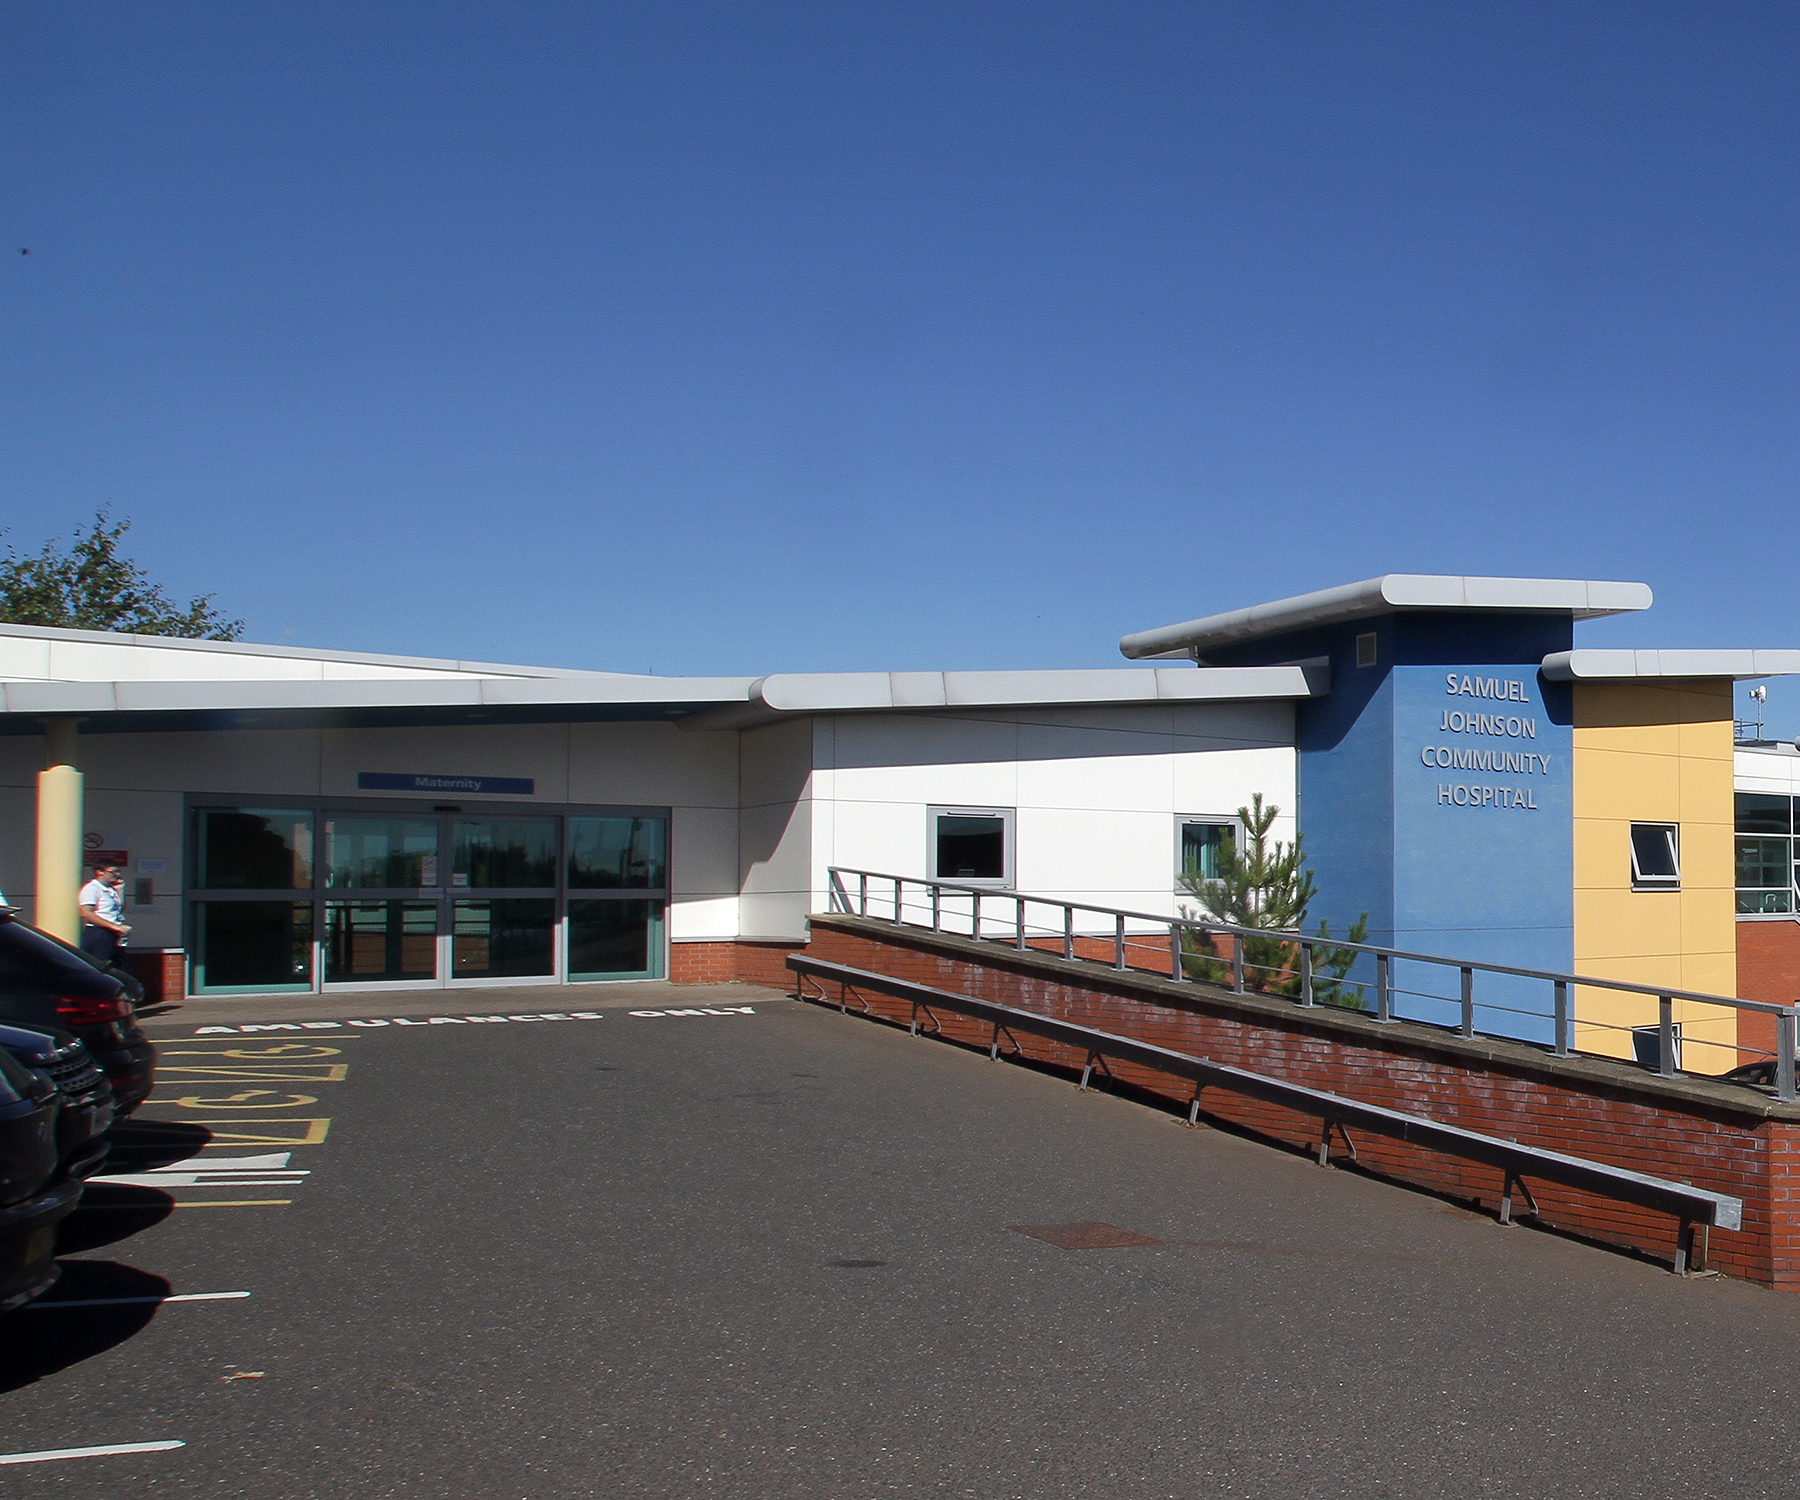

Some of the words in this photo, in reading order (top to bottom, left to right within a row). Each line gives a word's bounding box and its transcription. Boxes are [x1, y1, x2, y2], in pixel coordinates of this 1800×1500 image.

[1446, 673, 1530, 703] SAMUEL
[1439, 710, 1536, 739] JOHNSON
[1421, 745, 1552, 775] COMMUNITY
[414, 776, 482, 791] Maternity
[1437, 783, 1538, 810] HOSPITAL
[194, 1011, 604, 1035] AMBULANCES
[628, 1006, 756, 1018] ONLY
